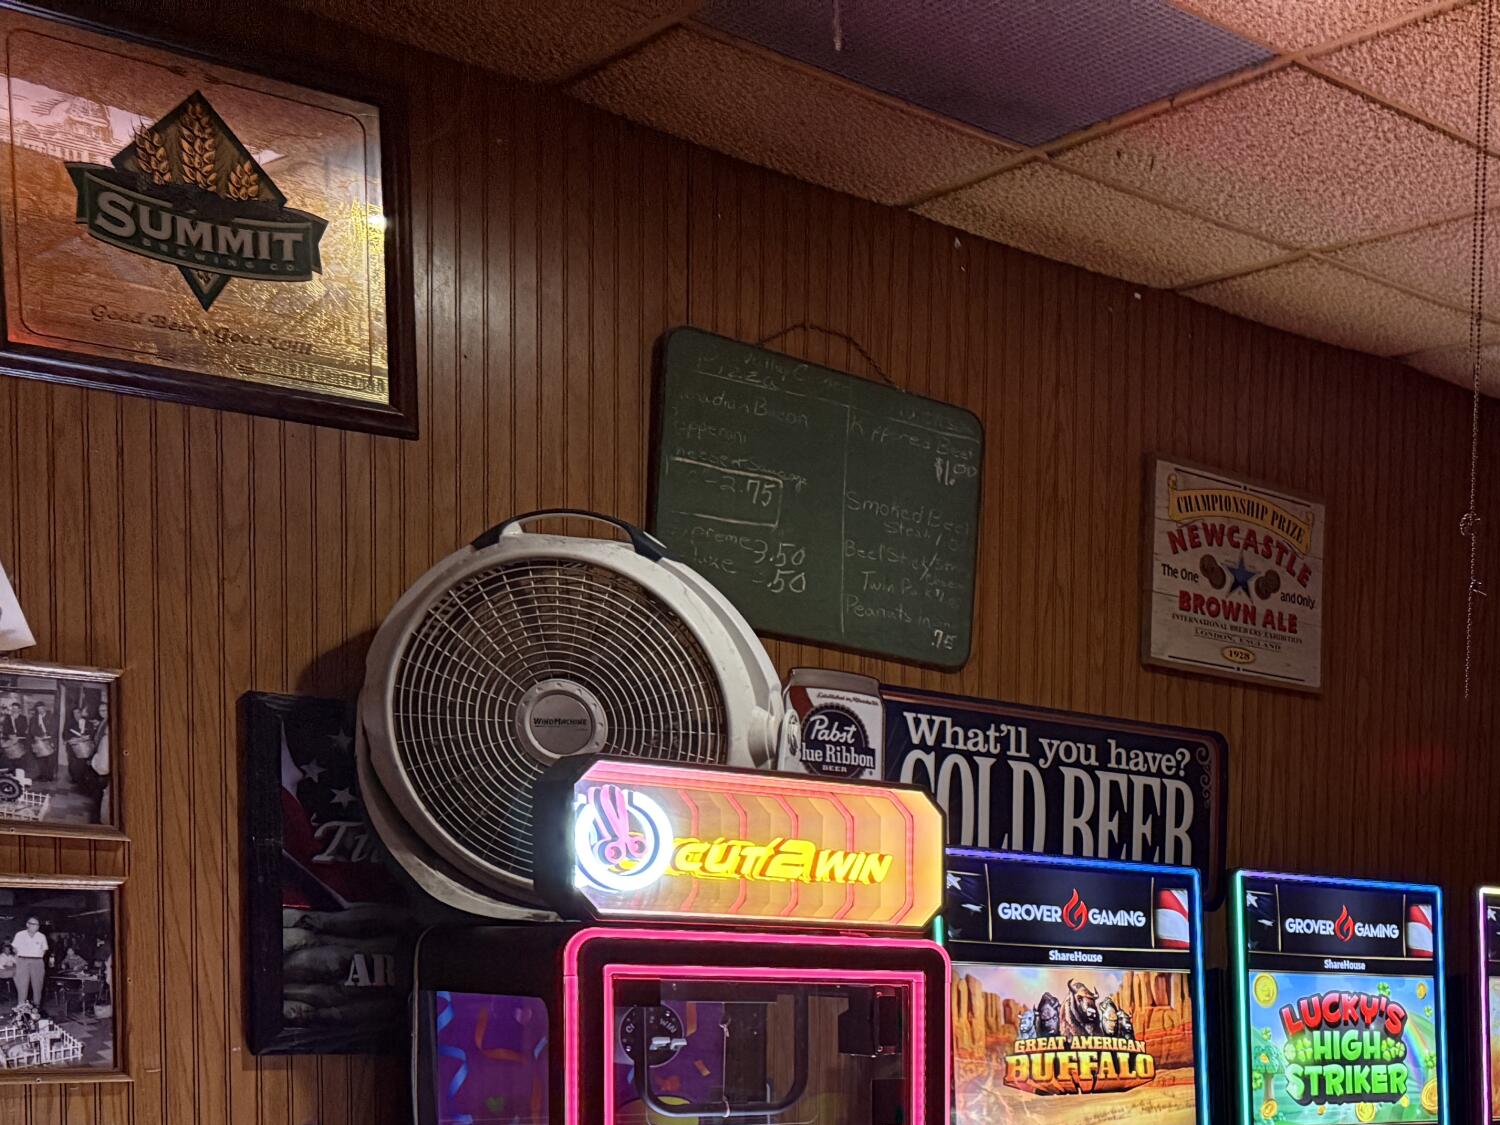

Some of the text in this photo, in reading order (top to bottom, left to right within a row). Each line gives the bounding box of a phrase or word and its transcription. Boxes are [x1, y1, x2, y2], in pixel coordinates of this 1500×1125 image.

[95, 191, 303, 262] SUMMIT
[1177, 492, 1307, 545] CHAMPIONSHIP PRIZE
[1167, 521, 1313, 589] NEWCASTLE
[1161, 563, 1200, 584] The One
[1178, 590, 1299, 635] BROWN ALE
[1280, 590, 1316, 610] and Only
[1227, 648, 1251, 662] 1928
[808, 713, 858, 745] Pabst
[902, 711, 1191, 778] What'll you have?
[801, 742, 875, 768] lue Ribbon
[821, 764, 848, 773] BEER
[1058, 765, 1196, 866] BEER
[673, 838, 893, 884] CUT WIN
[998, 902, 1146, 928] GROVER GAMING
[1285, 917, 1400, 939] GROVER GAMING
[1049, 950, 1103, 963] ShareHouse
[1324, 959, 1366, 971] ShareHouse
[1281, 992, 1408, 1036] LUCKY'S
[1014, 1036, 1146, 1052] GREAT AMERICAN
[1312, 1030, 1382, 1061] HIGH
[1005, 1051, 1156, 1083] BUFFALO
[1285, 1063, 1408, 1101] STRIKER
